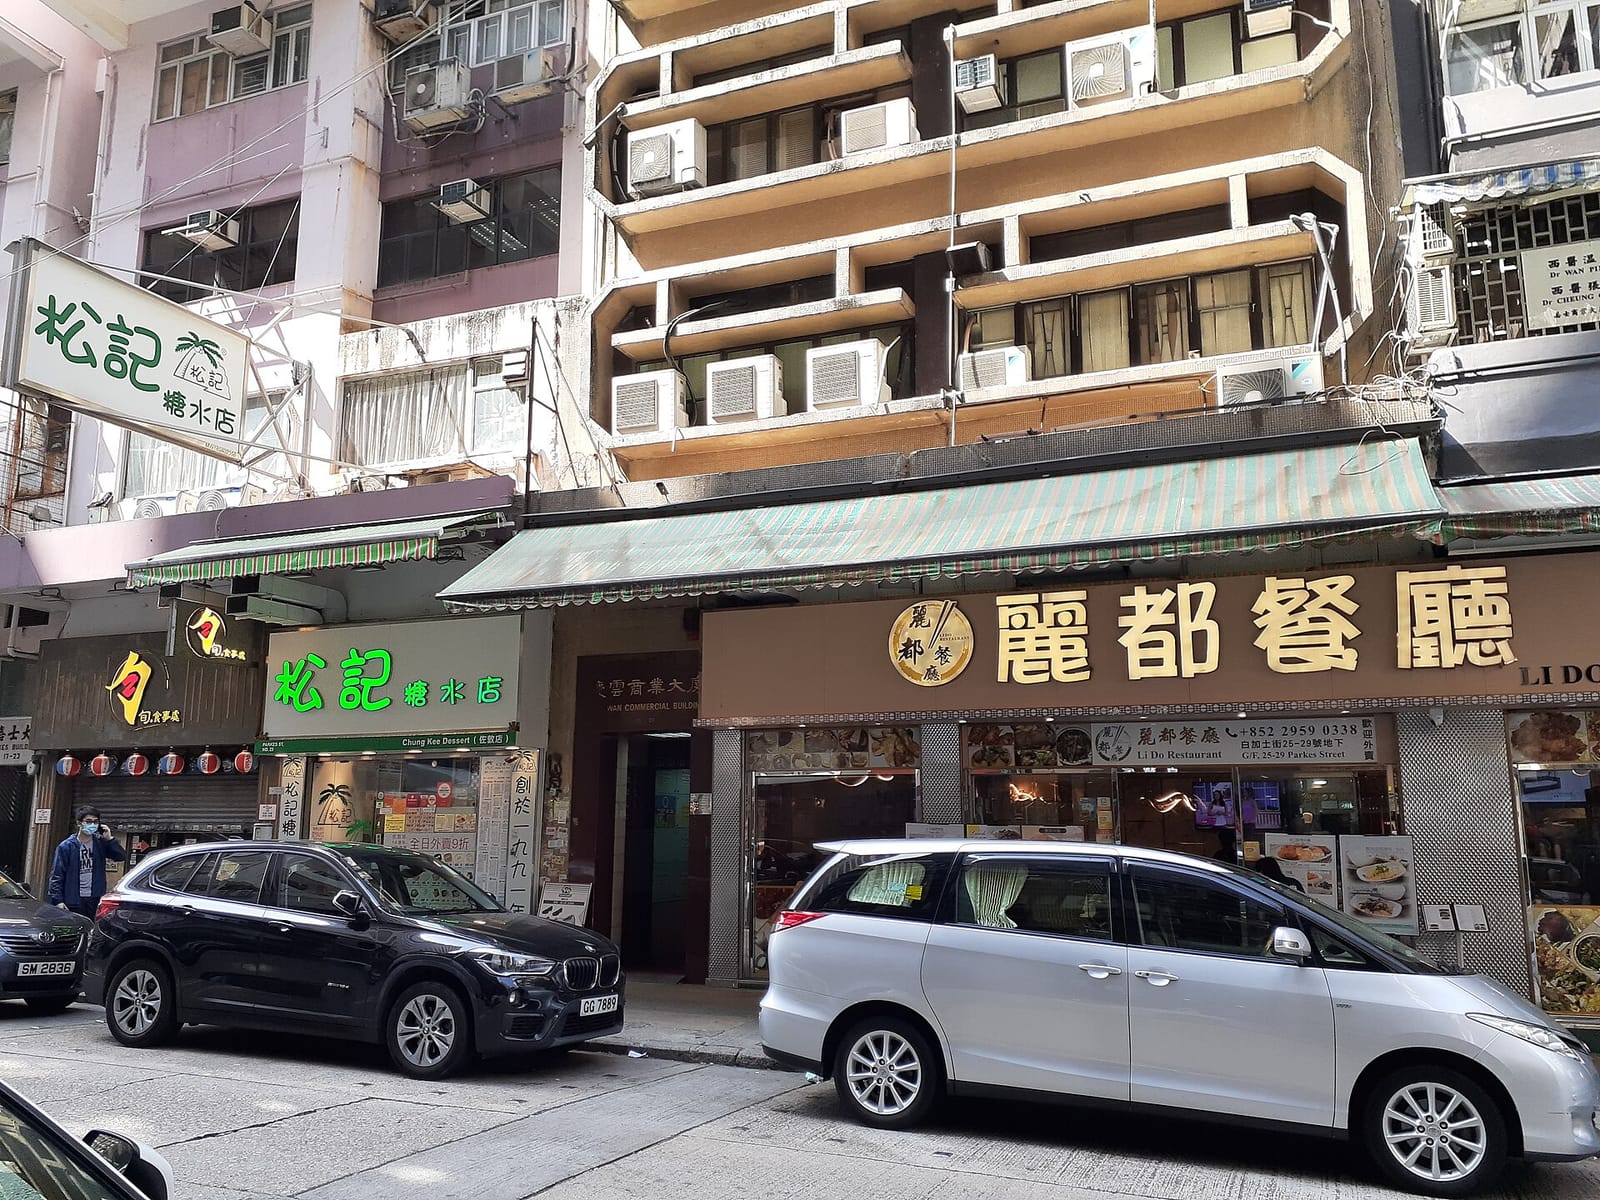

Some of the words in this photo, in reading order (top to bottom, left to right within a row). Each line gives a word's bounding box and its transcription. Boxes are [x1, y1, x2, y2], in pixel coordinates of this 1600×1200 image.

[1549, 271, 1561, 279] Dr
[1564, 267, 1585, 276] WAN
[1556, 293, 1595, 304] CHEUNG
[34, 294, 163, 393] 松記
[189, 363, 225, 392] 松記
[161, 389, 237, 435] 糖水店
[996, 565, 1519, 685] 麗都餐廳
[274, 647, 393, 714] 松記
[403, 675, 504, 708] 糖水店
[1519, 665, 1553, 686] LI
[624, 702, 670, 712] COMMERCIAL
[1137, 725, 1220, 746] 麗都餐廳
[1239, 726, 1275, 737] +852
[1281, 725, 1316, 737] 2959
[1322, 724, 1358, 736] 0338
[1361, 718, 1375, 761] 歡迎外賣
[402, 738, 426, 747] Chung
[427, 737, 441, 745] Kee
[442, 736, 470, 745] Dessert
[1137, 751, 1148, 760] Li
[1151, 750, 1165, 760] Do
[1167, 749, 1222, 760] Restaurant
[1262, 751, 1286, 760] 25-29
[1319, 750, 1346, 758] Street
[281, 780, 300, 837] 松記糖
[22, 963, 38, 974] SM
[40, 962, 72, 974] 2836
[583, 1000, 596, 1013] GG
[597, 997, 617, 1012] 7889
